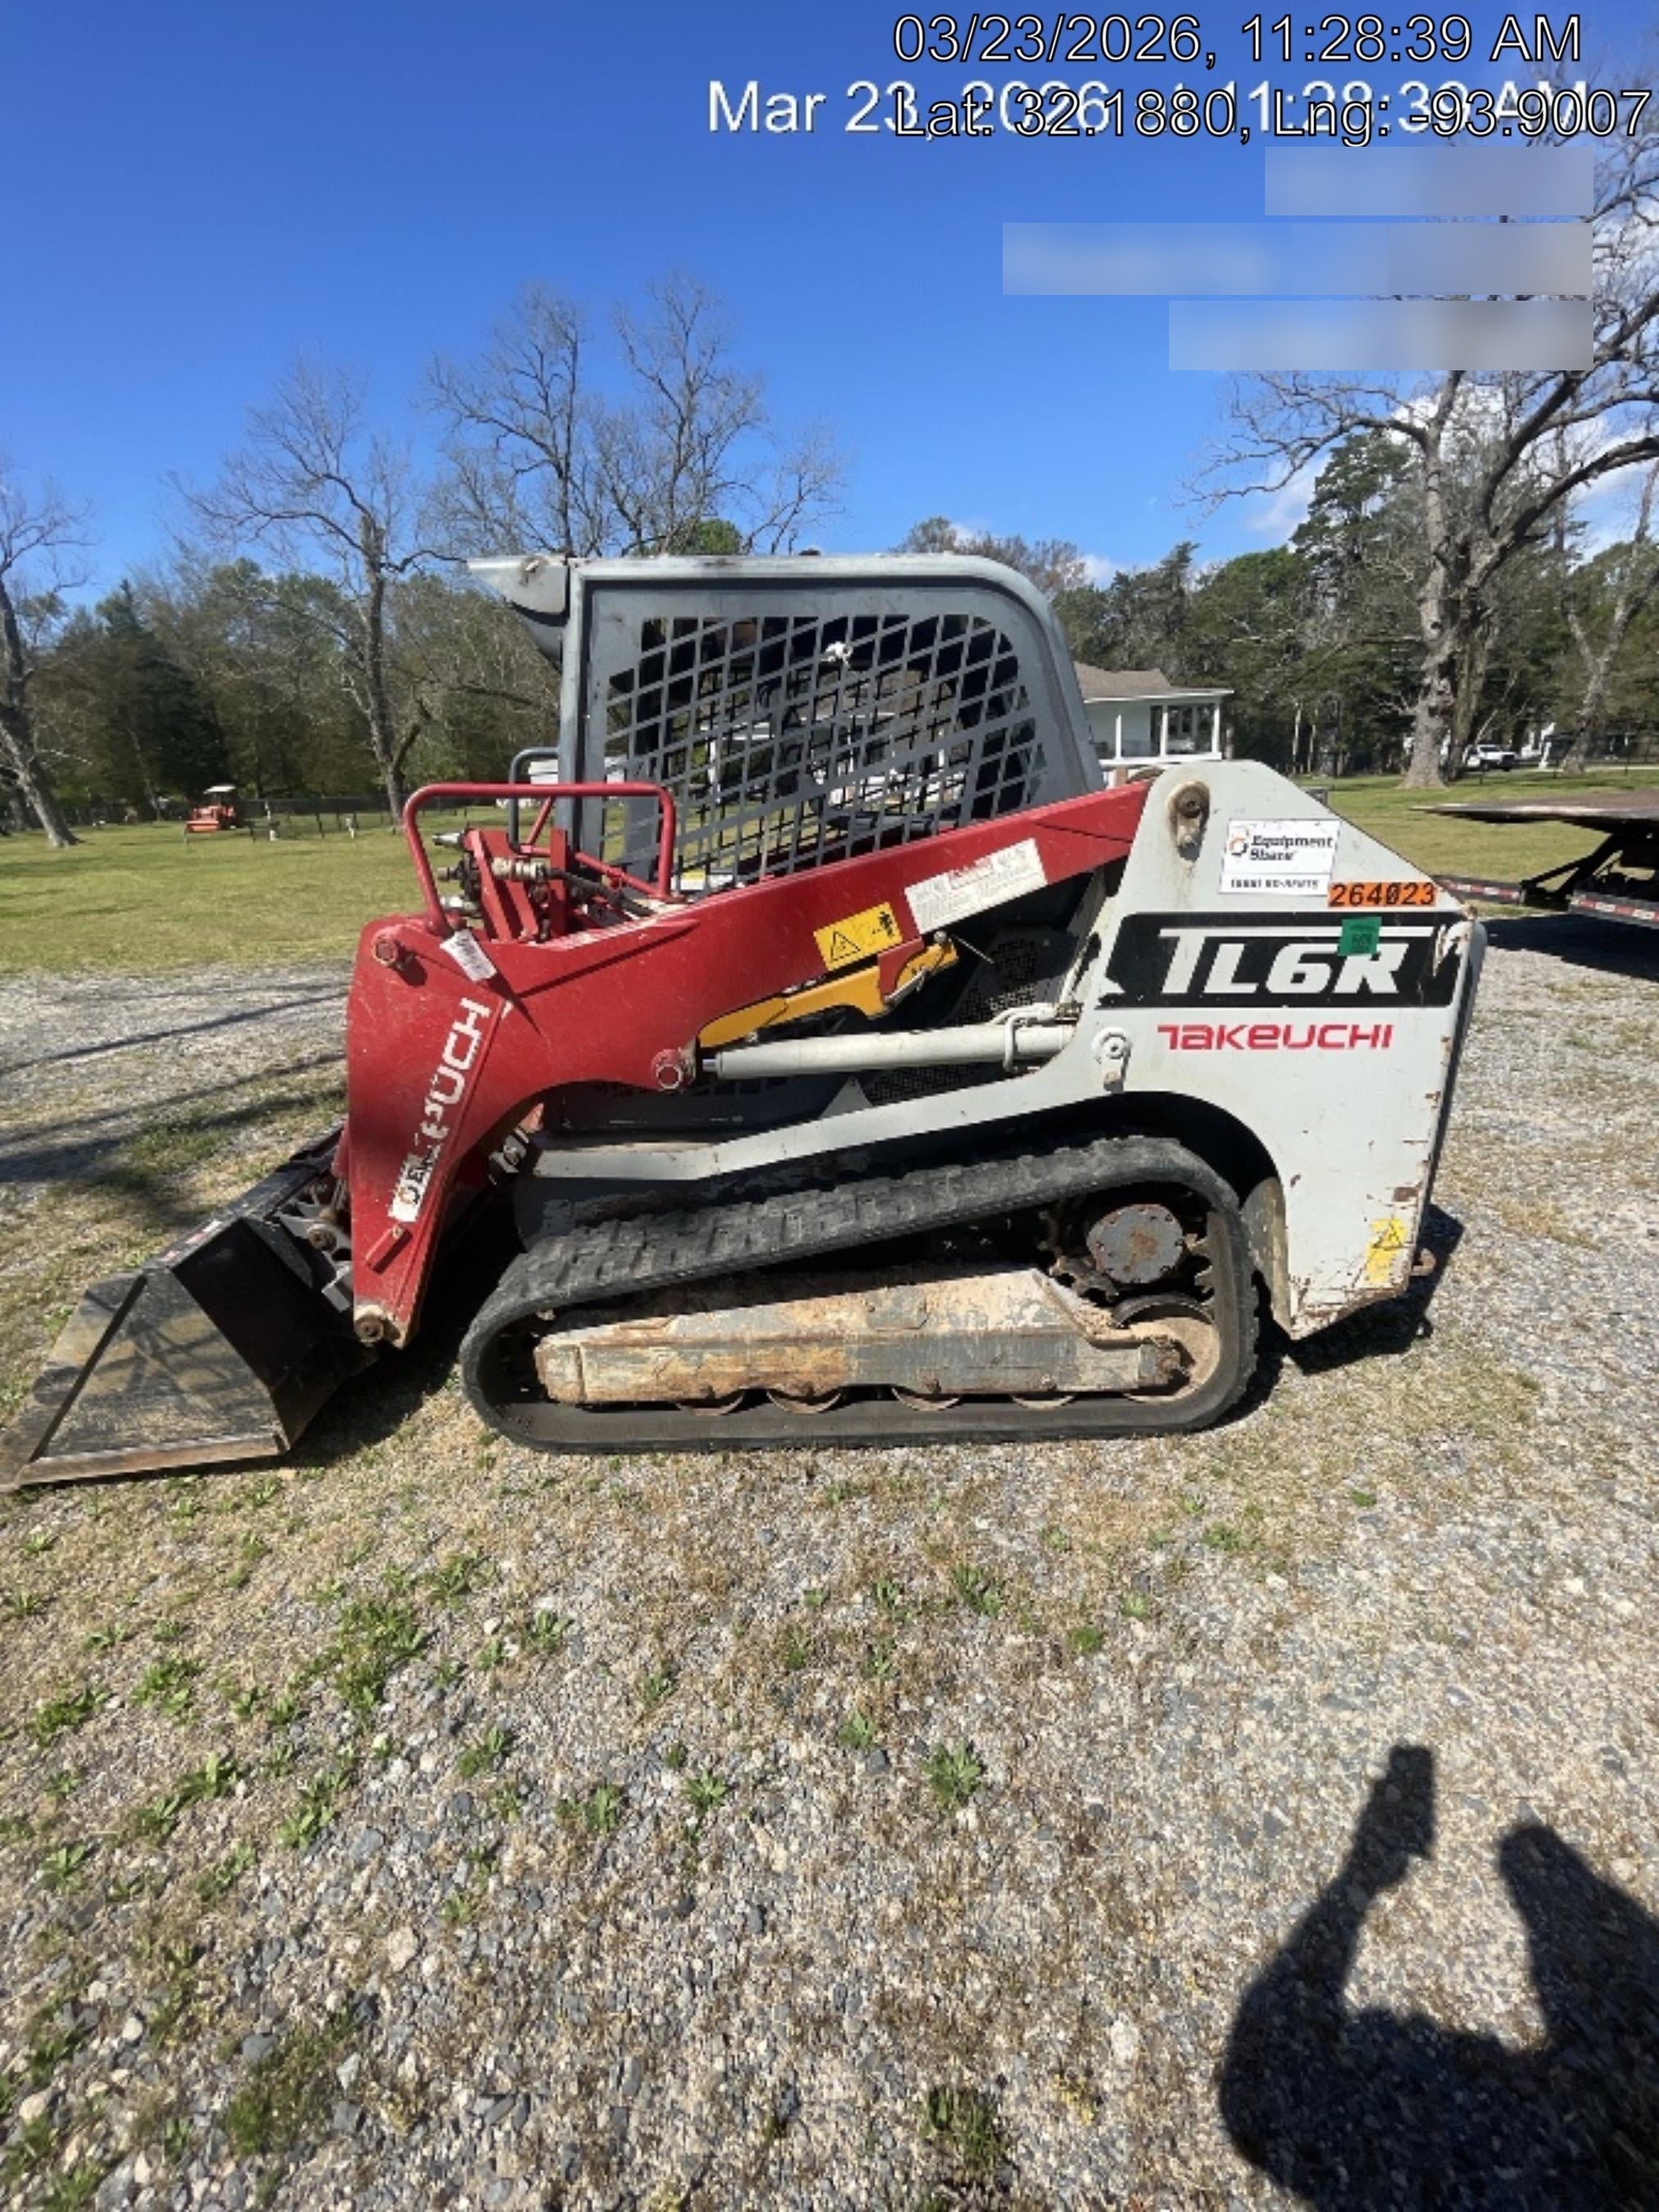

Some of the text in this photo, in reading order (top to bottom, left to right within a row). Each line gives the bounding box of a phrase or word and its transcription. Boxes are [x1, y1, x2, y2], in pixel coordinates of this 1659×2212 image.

[1251, 835, 1334, 849] Equipment
[1249, 849, 1294, 861] Share
[1329, 882, 1436, 907] 264023
[1158, 926, 1435, 994] TL6R
[1157, 1024, 1394, 1050] TAKEUCHI
